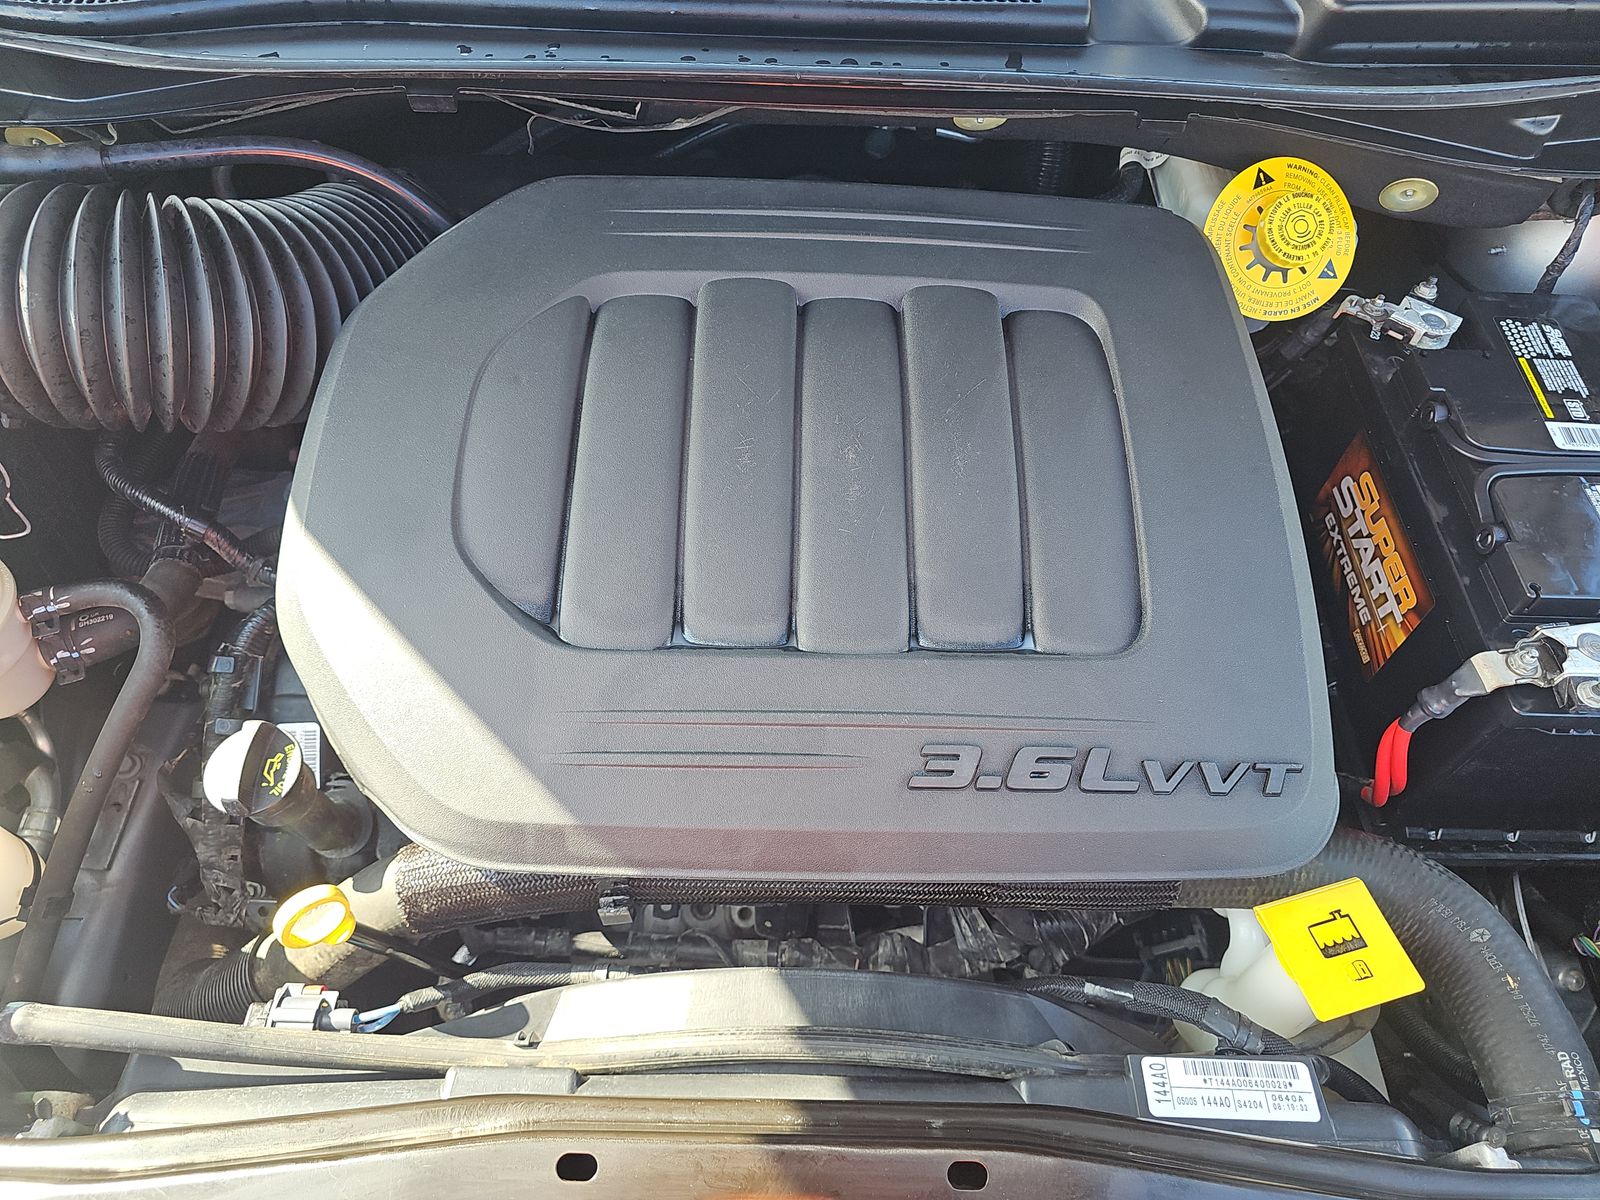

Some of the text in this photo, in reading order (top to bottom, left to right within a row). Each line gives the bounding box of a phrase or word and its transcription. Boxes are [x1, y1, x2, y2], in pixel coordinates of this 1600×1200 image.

[1283, 182, 1301, 191] FROM
[1283, 195, 1291, 203] LE
[1286, 162, 1320, 180] WARNING:
[1320, 178, 1336, 197] CLEAN
[1334, 195, 1345, 216] FILLER
[1342, 216, 1350, 230] CAP
[1292, 191, 1314, 199] BOUCHON
[1315, 195, 1322, 203] DE
[1217, 220, 1226, 232] DU
[1222, 194, 1242, 220] LIQUIDE
[1313, 207, 1322, 217] CAP
[1322, 201, 1335, 235] REMPLISSAGE
[1317, 186, 1328, 199] USE
[1335, 237, 1343, 256] FLUID
[1316, 220, 1325, 239] BEFORE
[1319, 236, 1332, 252] AVANT
[1225, 239, 1240, 277] CONTENANT
[1251, 286, 1291, 298] PROVENANT
[1299, 280, 1312, 292] DOT
[1284, 298, 1294, 306] DE
[1297, 289, 1315, 304] AVANT
[1302, 296, 1320, 309] MISE
[1275, 300, 1283, 308] LE
[1290, 305, 1301, 313] EN
[1332, 475, 1404, 624] START
[1352, 471, 1417, 615] SUPER
[1324, 511, 1372, 626] EXTREME
[1557, 1051, 1577, 1078] RAD
[1570, 1051, 1591, 1091] MEXICO
[1176, 1096, 1198, 1106] 05005
[1236, 1099, 1264, 1109] S4204
